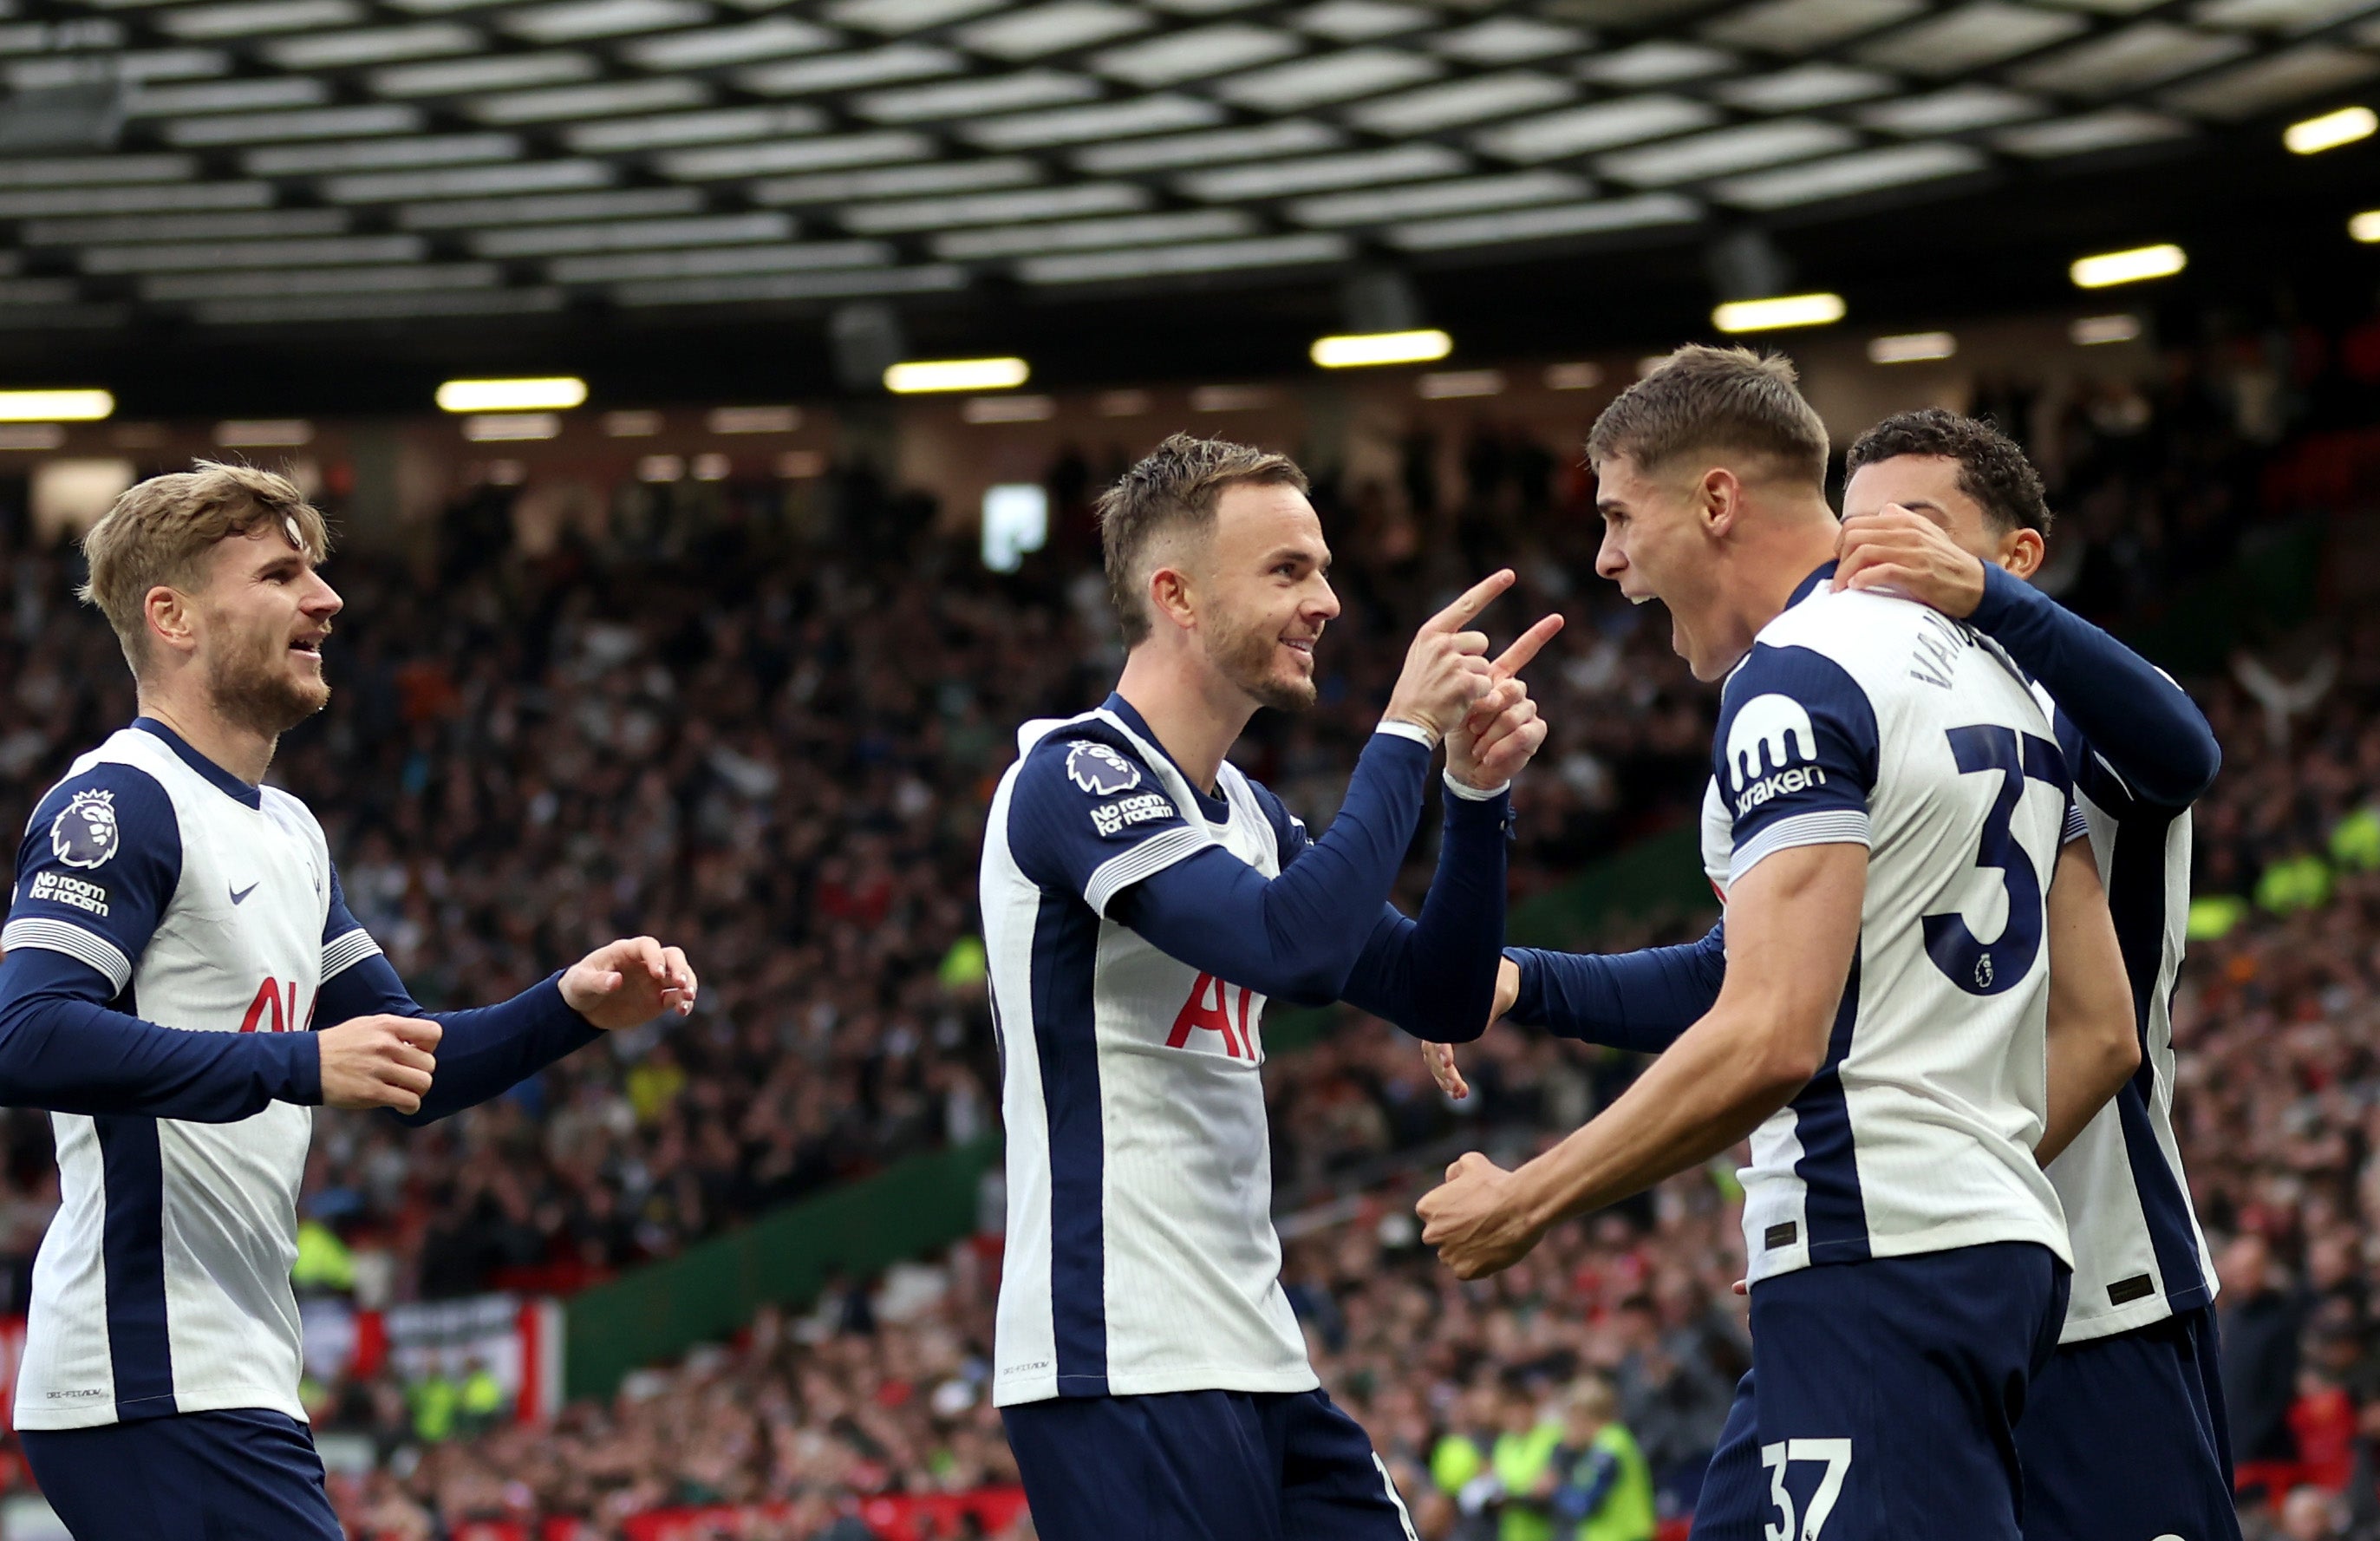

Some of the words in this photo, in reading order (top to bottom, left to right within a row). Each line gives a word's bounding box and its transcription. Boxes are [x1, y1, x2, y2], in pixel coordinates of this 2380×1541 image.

[1090, 804, 1119, 821] No
[1118, 794, 1165, 813] room
[1736, 765, 1826, 819] kraken
[1097, 813, 1123, 837] for
[1123, 805, 1174, 825] racism
[1920, 724, 2074, 996] 37
[29, 884, 55, 899] for
[53, 889, 109, 917] racism
[33, 872, 58, 887] No
[58, 876, 106, 901] room
[238, 976, 319, 1033] AI
[1761, 1438, 1852, 1541] 37
